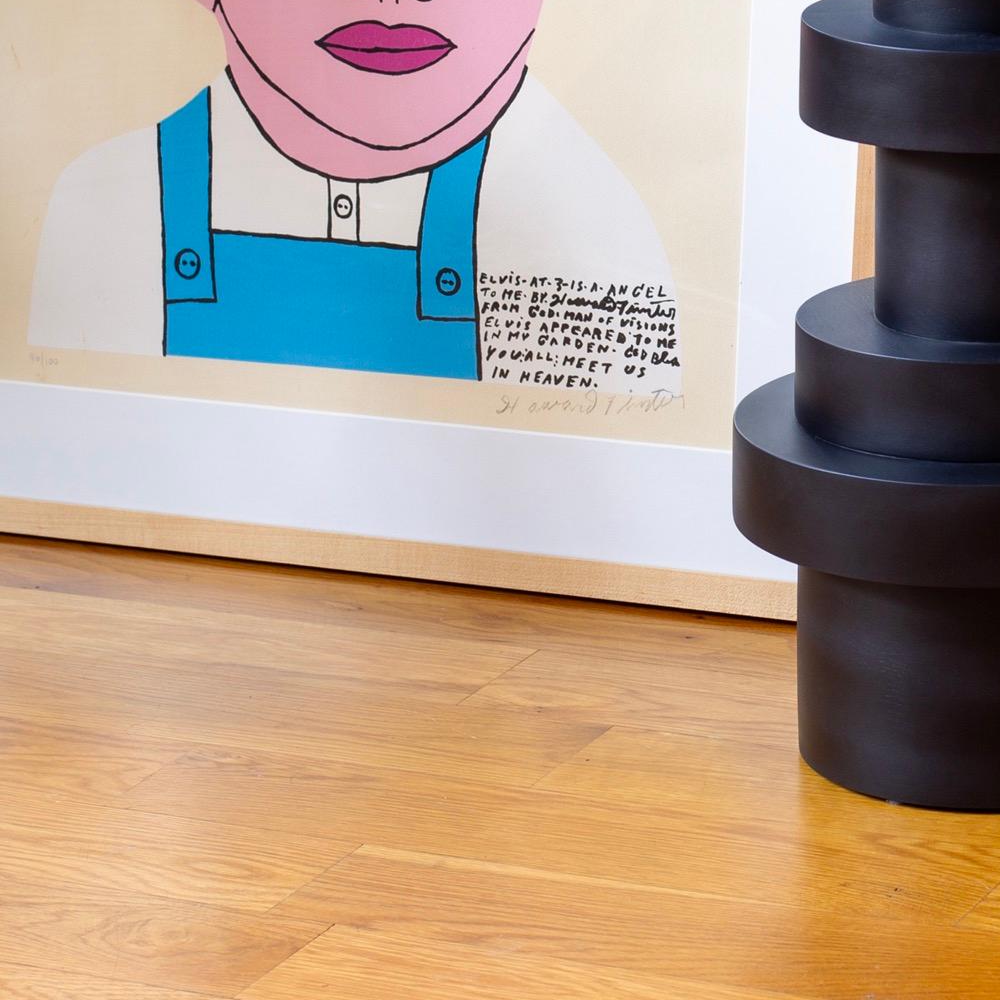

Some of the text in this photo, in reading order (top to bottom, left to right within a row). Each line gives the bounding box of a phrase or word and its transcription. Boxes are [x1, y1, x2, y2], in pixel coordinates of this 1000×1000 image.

[480, 287, 496, 298] TO
[481, 301, 520, 314] FROM
[563, 310, 593, 323] MAN
[598, 316, 614, 326] OF
[484, 330, 501, 342] IN
[507, 330, 530, 342] MY
[624, 344, 648, 361] GOD
[540, 321, 627, 345] APPEARED
[656, 338, 677, 349] ME
[492, 366, 510, 379] IN
[562, 354, 613, 375] MEET
[624, 365, 647, 378] US
